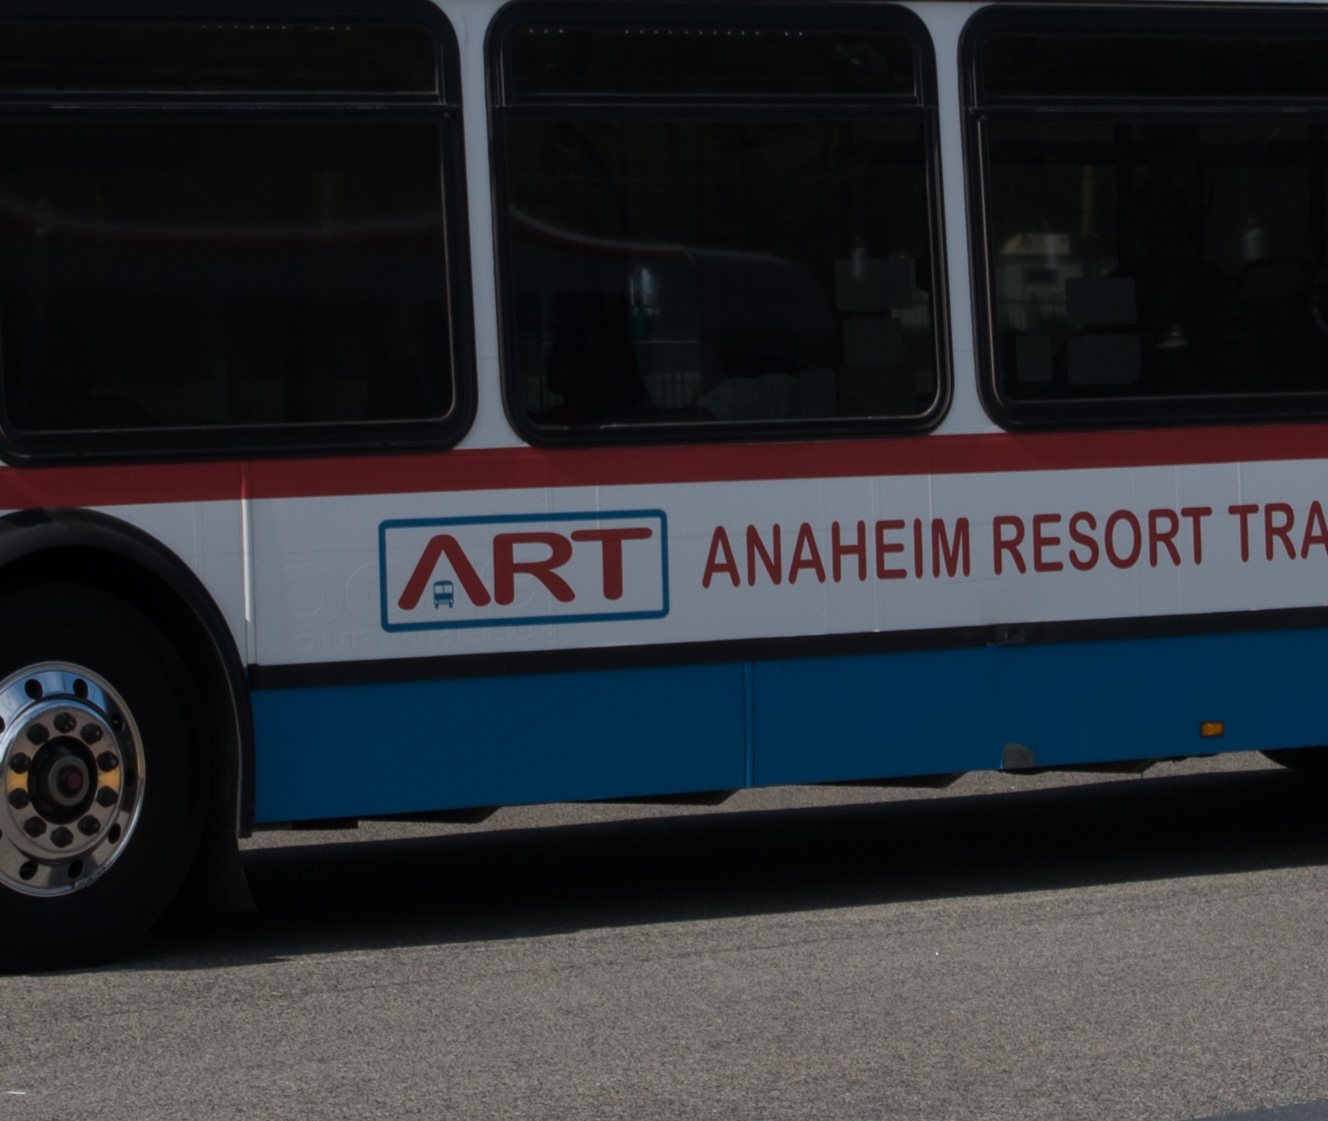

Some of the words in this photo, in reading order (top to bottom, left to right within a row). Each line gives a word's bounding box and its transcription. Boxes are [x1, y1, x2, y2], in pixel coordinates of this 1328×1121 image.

[397, 526, 654, 612] ART
[701, 517, 972, 589] ANAHEIM
[992, 505, 1213, 576] RESORT
